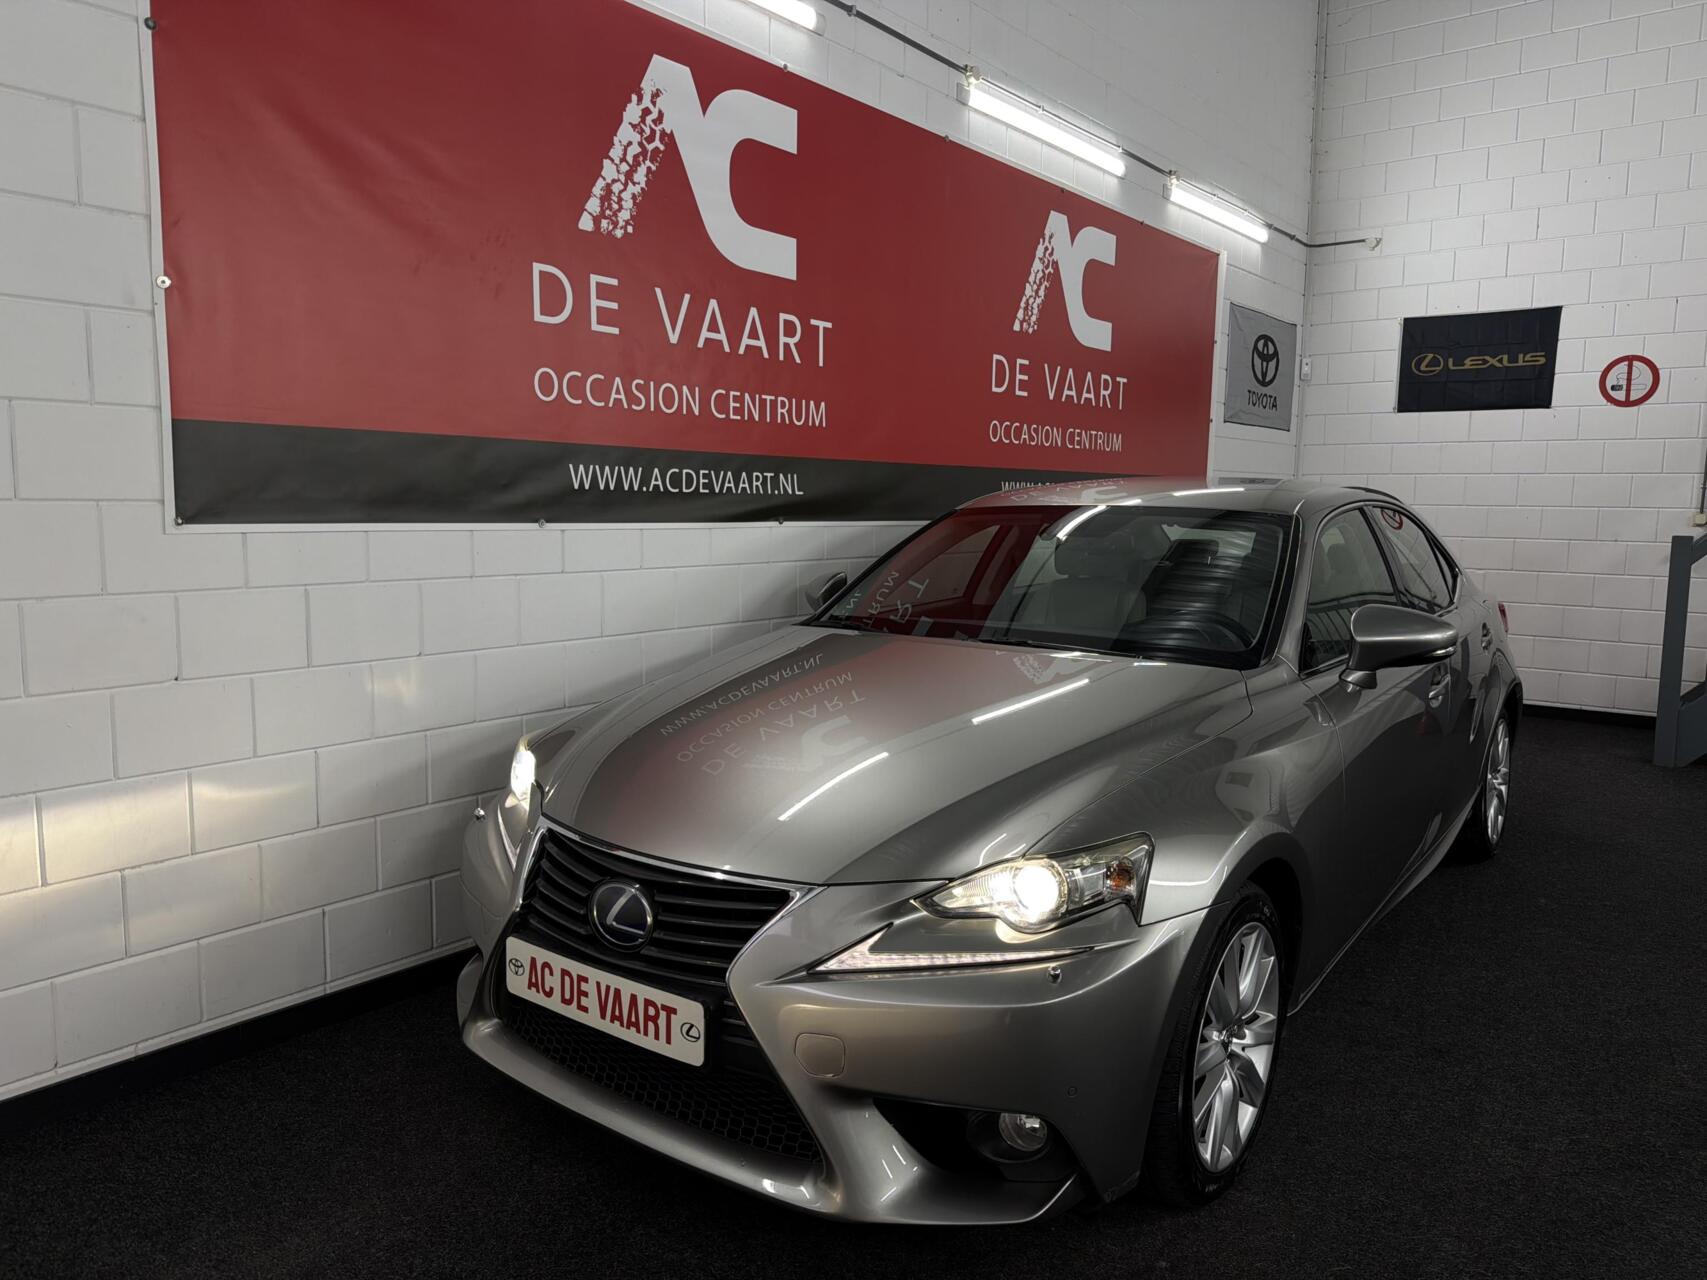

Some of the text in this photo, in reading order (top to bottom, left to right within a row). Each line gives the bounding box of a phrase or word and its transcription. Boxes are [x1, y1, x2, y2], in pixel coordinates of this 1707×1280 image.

[532, 261, 833, 367] DE VAART
[991, 353, 1128, 410] DE VAART
[1448, 352, 1546, 370] LEXUS
[533, 367, 827, 428] OCCASION CENTRUM
[1247, 389, 1278, 412] TOYOTA
[989, 420, 1122, 452] OCCASION CENTRUM
[568, 463, 804, 496] WWW.ACDEVAART.NL
[527, 956, 678, 1044] AC DE VAART
